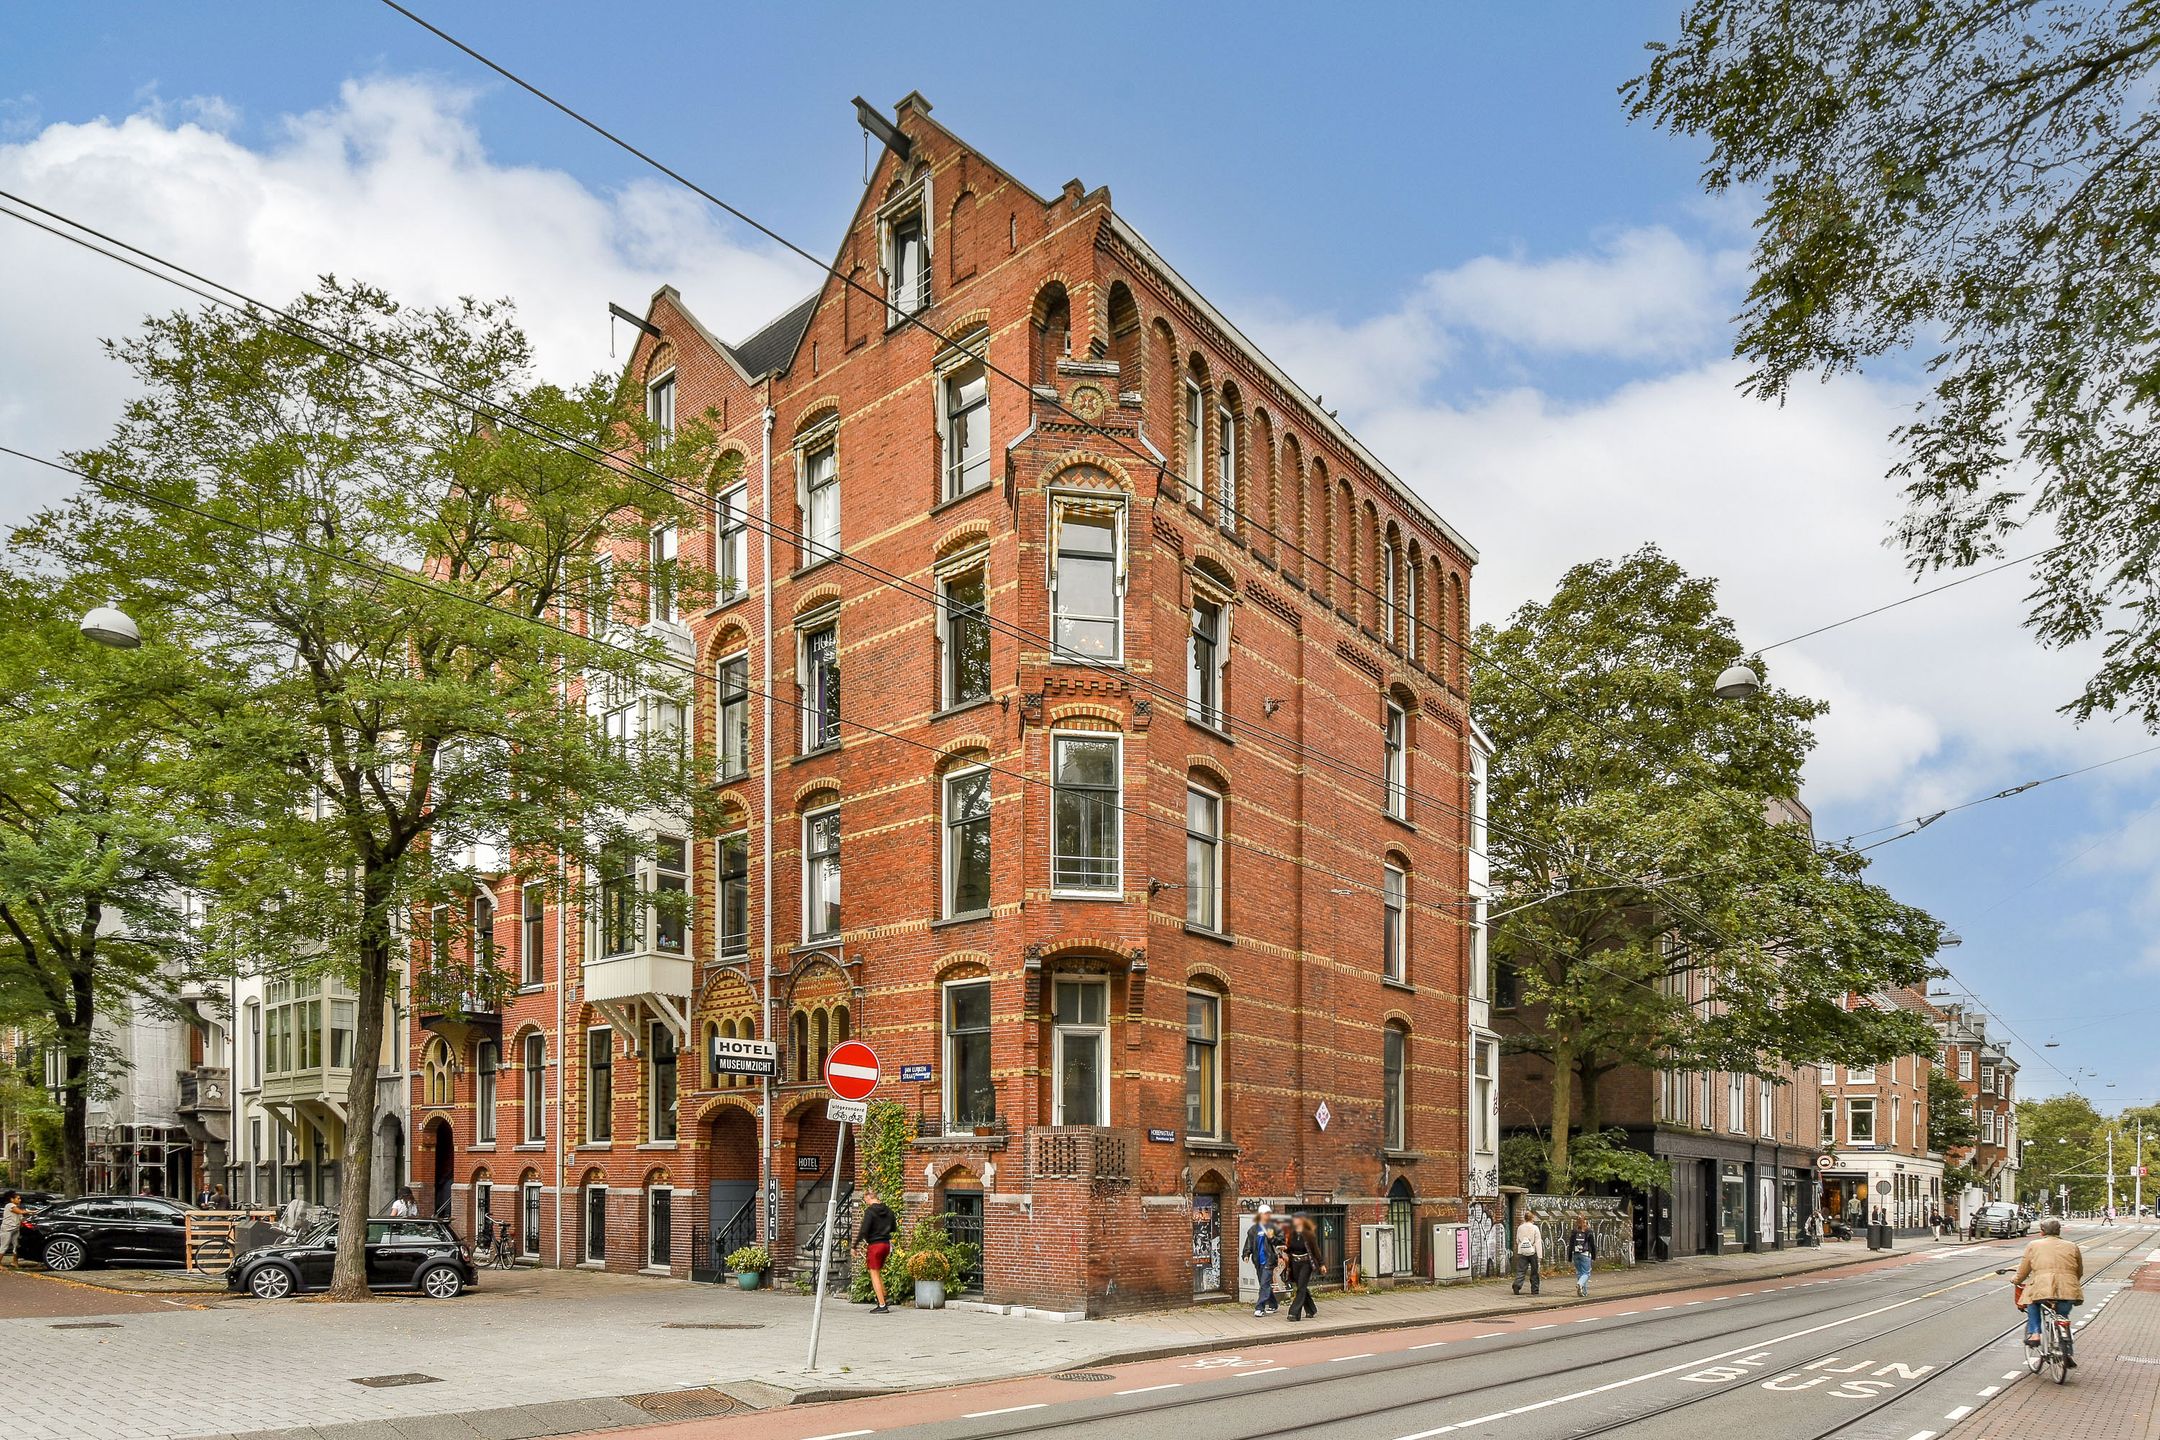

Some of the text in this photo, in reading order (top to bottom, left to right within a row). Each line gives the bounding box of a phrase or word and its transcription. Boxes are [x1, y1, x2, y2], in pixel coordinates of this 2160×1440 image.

[719, 1041, 772, 1056] HOTEL
[719, 1058, 771, 1072] MUSEUMZICHT
[798, 1157, 818, 1168] HOTEL
[1677, 1366, 1897, 1399] BUS
